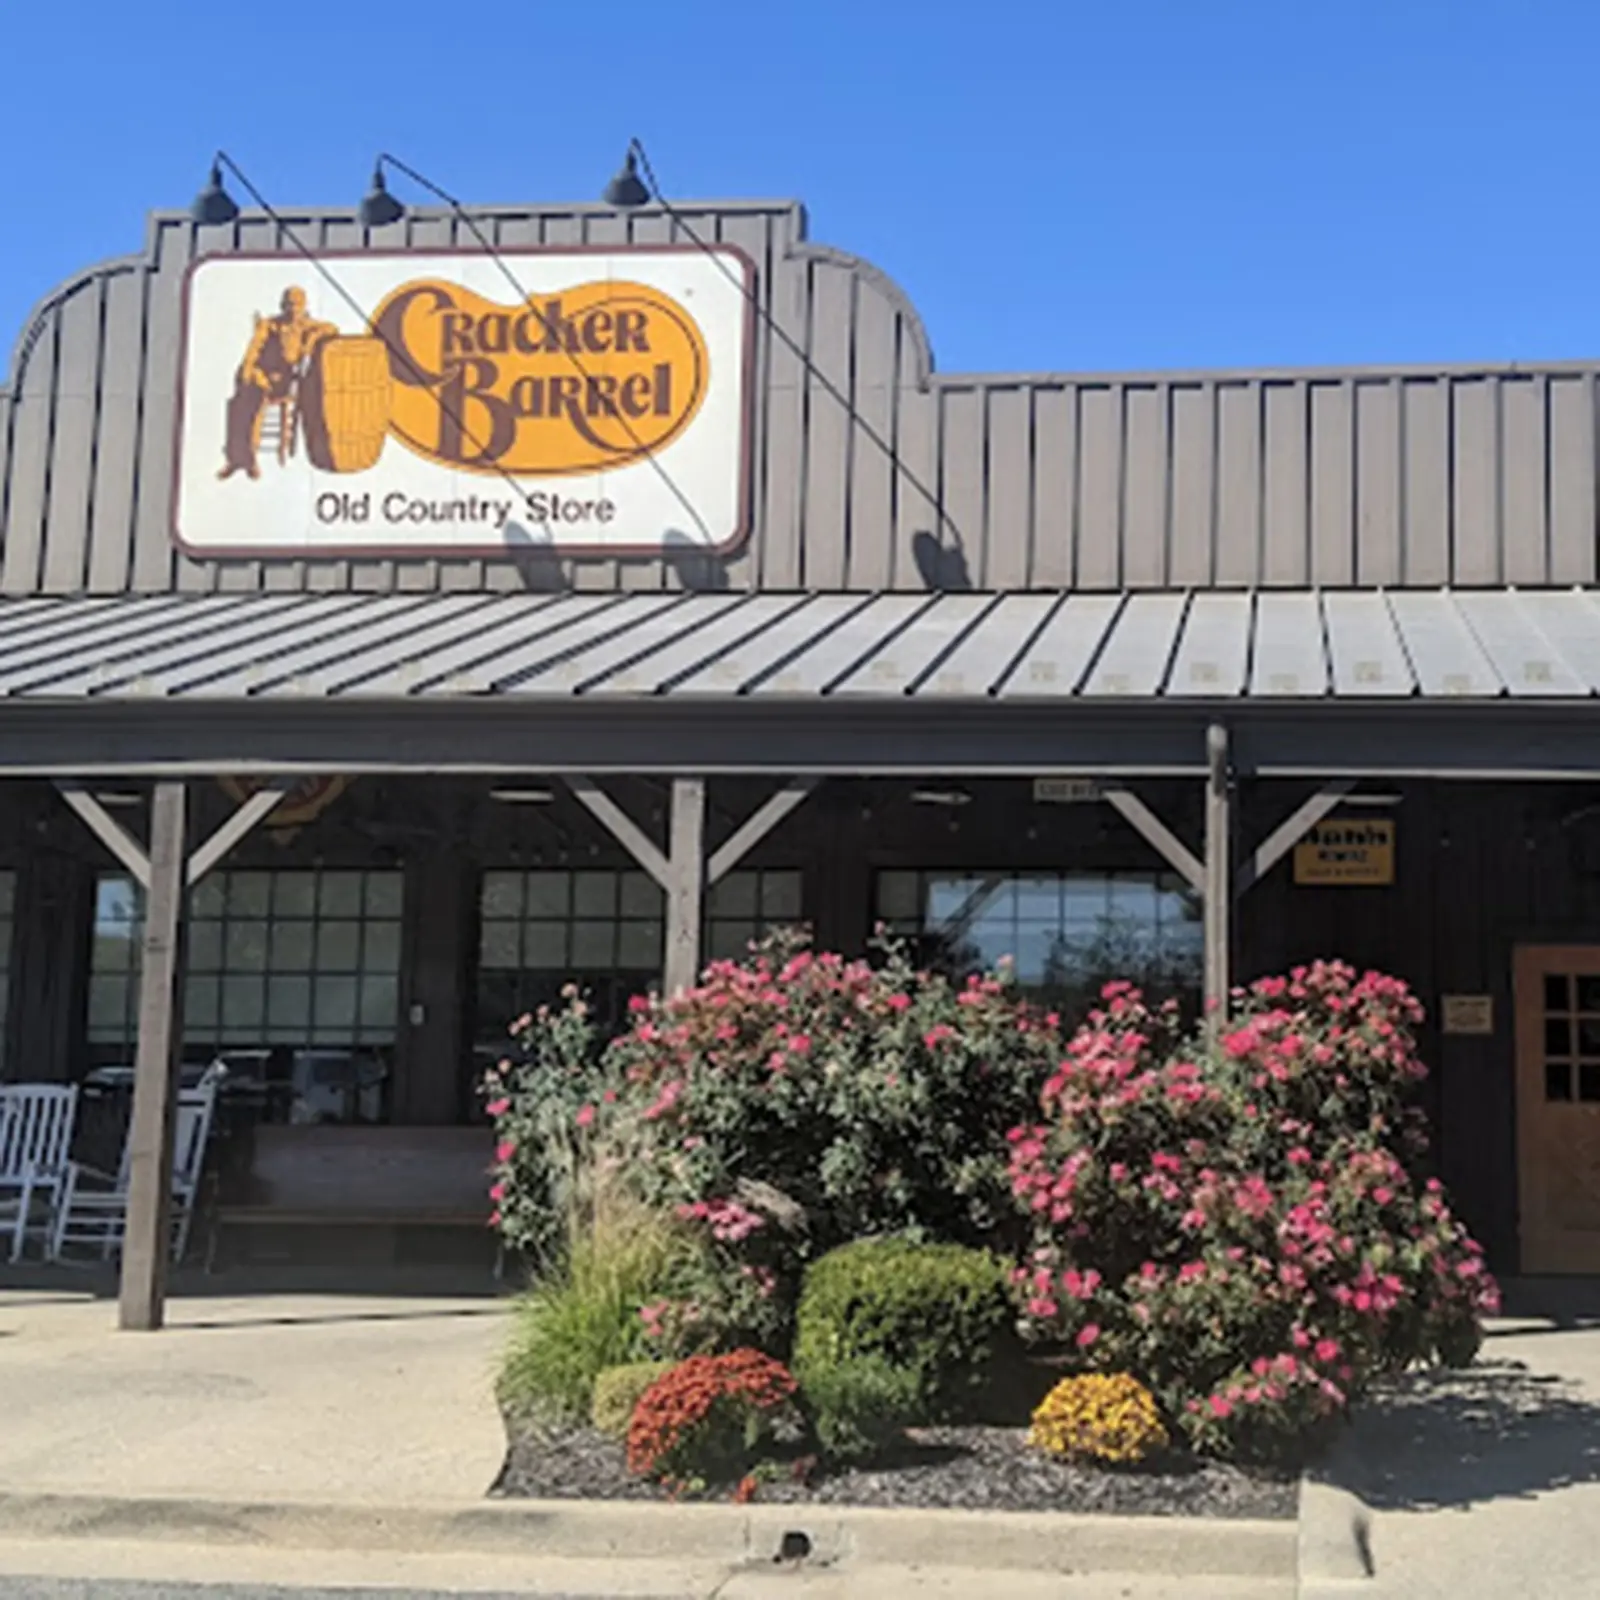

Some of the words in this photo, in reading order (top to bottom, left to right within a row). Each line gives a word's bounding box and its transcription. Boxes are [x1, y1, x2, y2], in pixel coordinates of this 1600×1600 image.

[315, 491, 370, 524] Old
[381, 491, 512, 529] Country
[525, 491, 616, 524] Store
